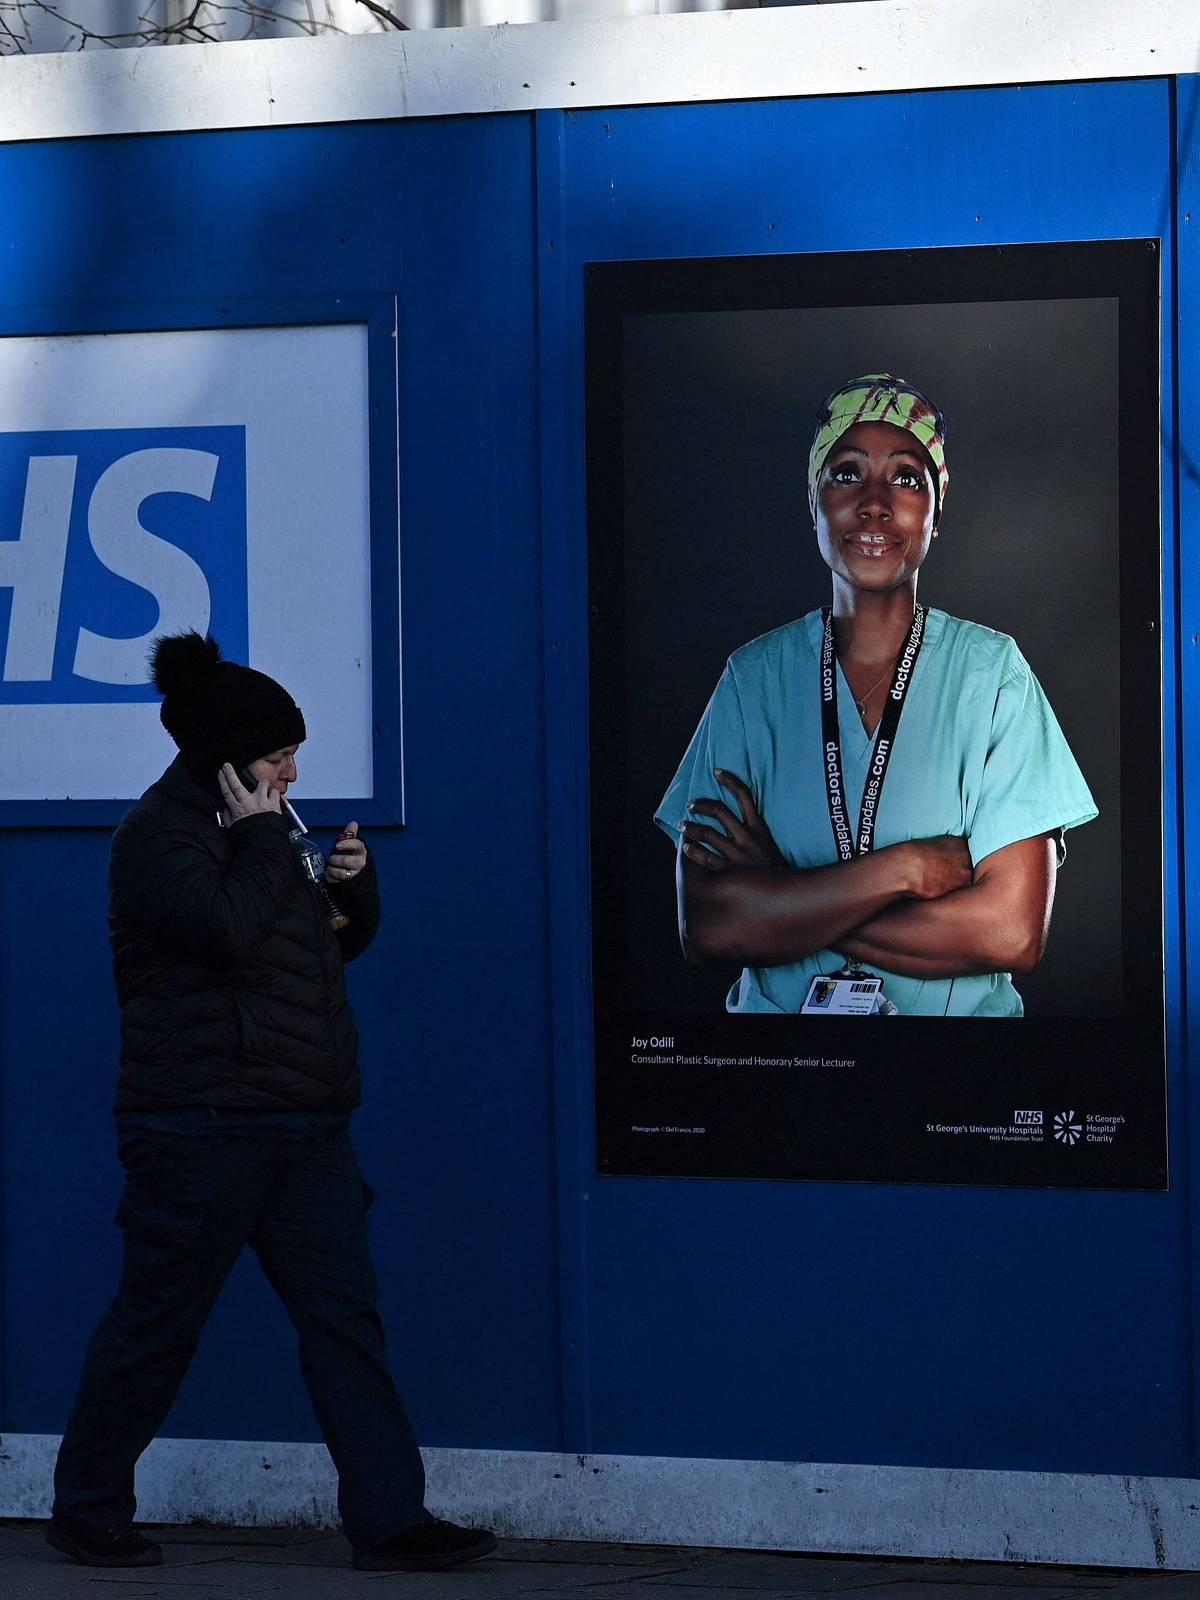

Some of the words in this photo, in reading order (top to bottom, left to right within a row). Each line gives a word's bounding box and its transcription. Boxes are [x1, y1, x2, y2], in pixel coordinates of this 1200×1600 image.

[631, 1036, 649, 1050] Joy
[649, 1036, 675, 1048] Odili
[631, 1054, 675, 1064] Consultant
[676, 1055, 702, 1065] Plastic
[703, 1055, 737, 1067] Surgeon
[737, 1056, 752, 1066] and
[754, 1056, 792, 1068] Honorary
[794, 1057, 820, 1067] Senior
[821, 1057, 856, 1068] Lecturer
[1015, 1111, 1042, 1124] NHS
[1086, 1114, 1094, 1122] St
[1094, 1114, 1125, 1124] George's
[926, 1123, 935, 1132] St
[936, 1124, 968, 1134] George's
[969, 1125, 1007, 1136] University
[1008, 1126, 1044, 1136] Hospitals
[1086, 1124, 1116, 1134] Hospital
[1086, 1134, 1113, 1144] Charity
